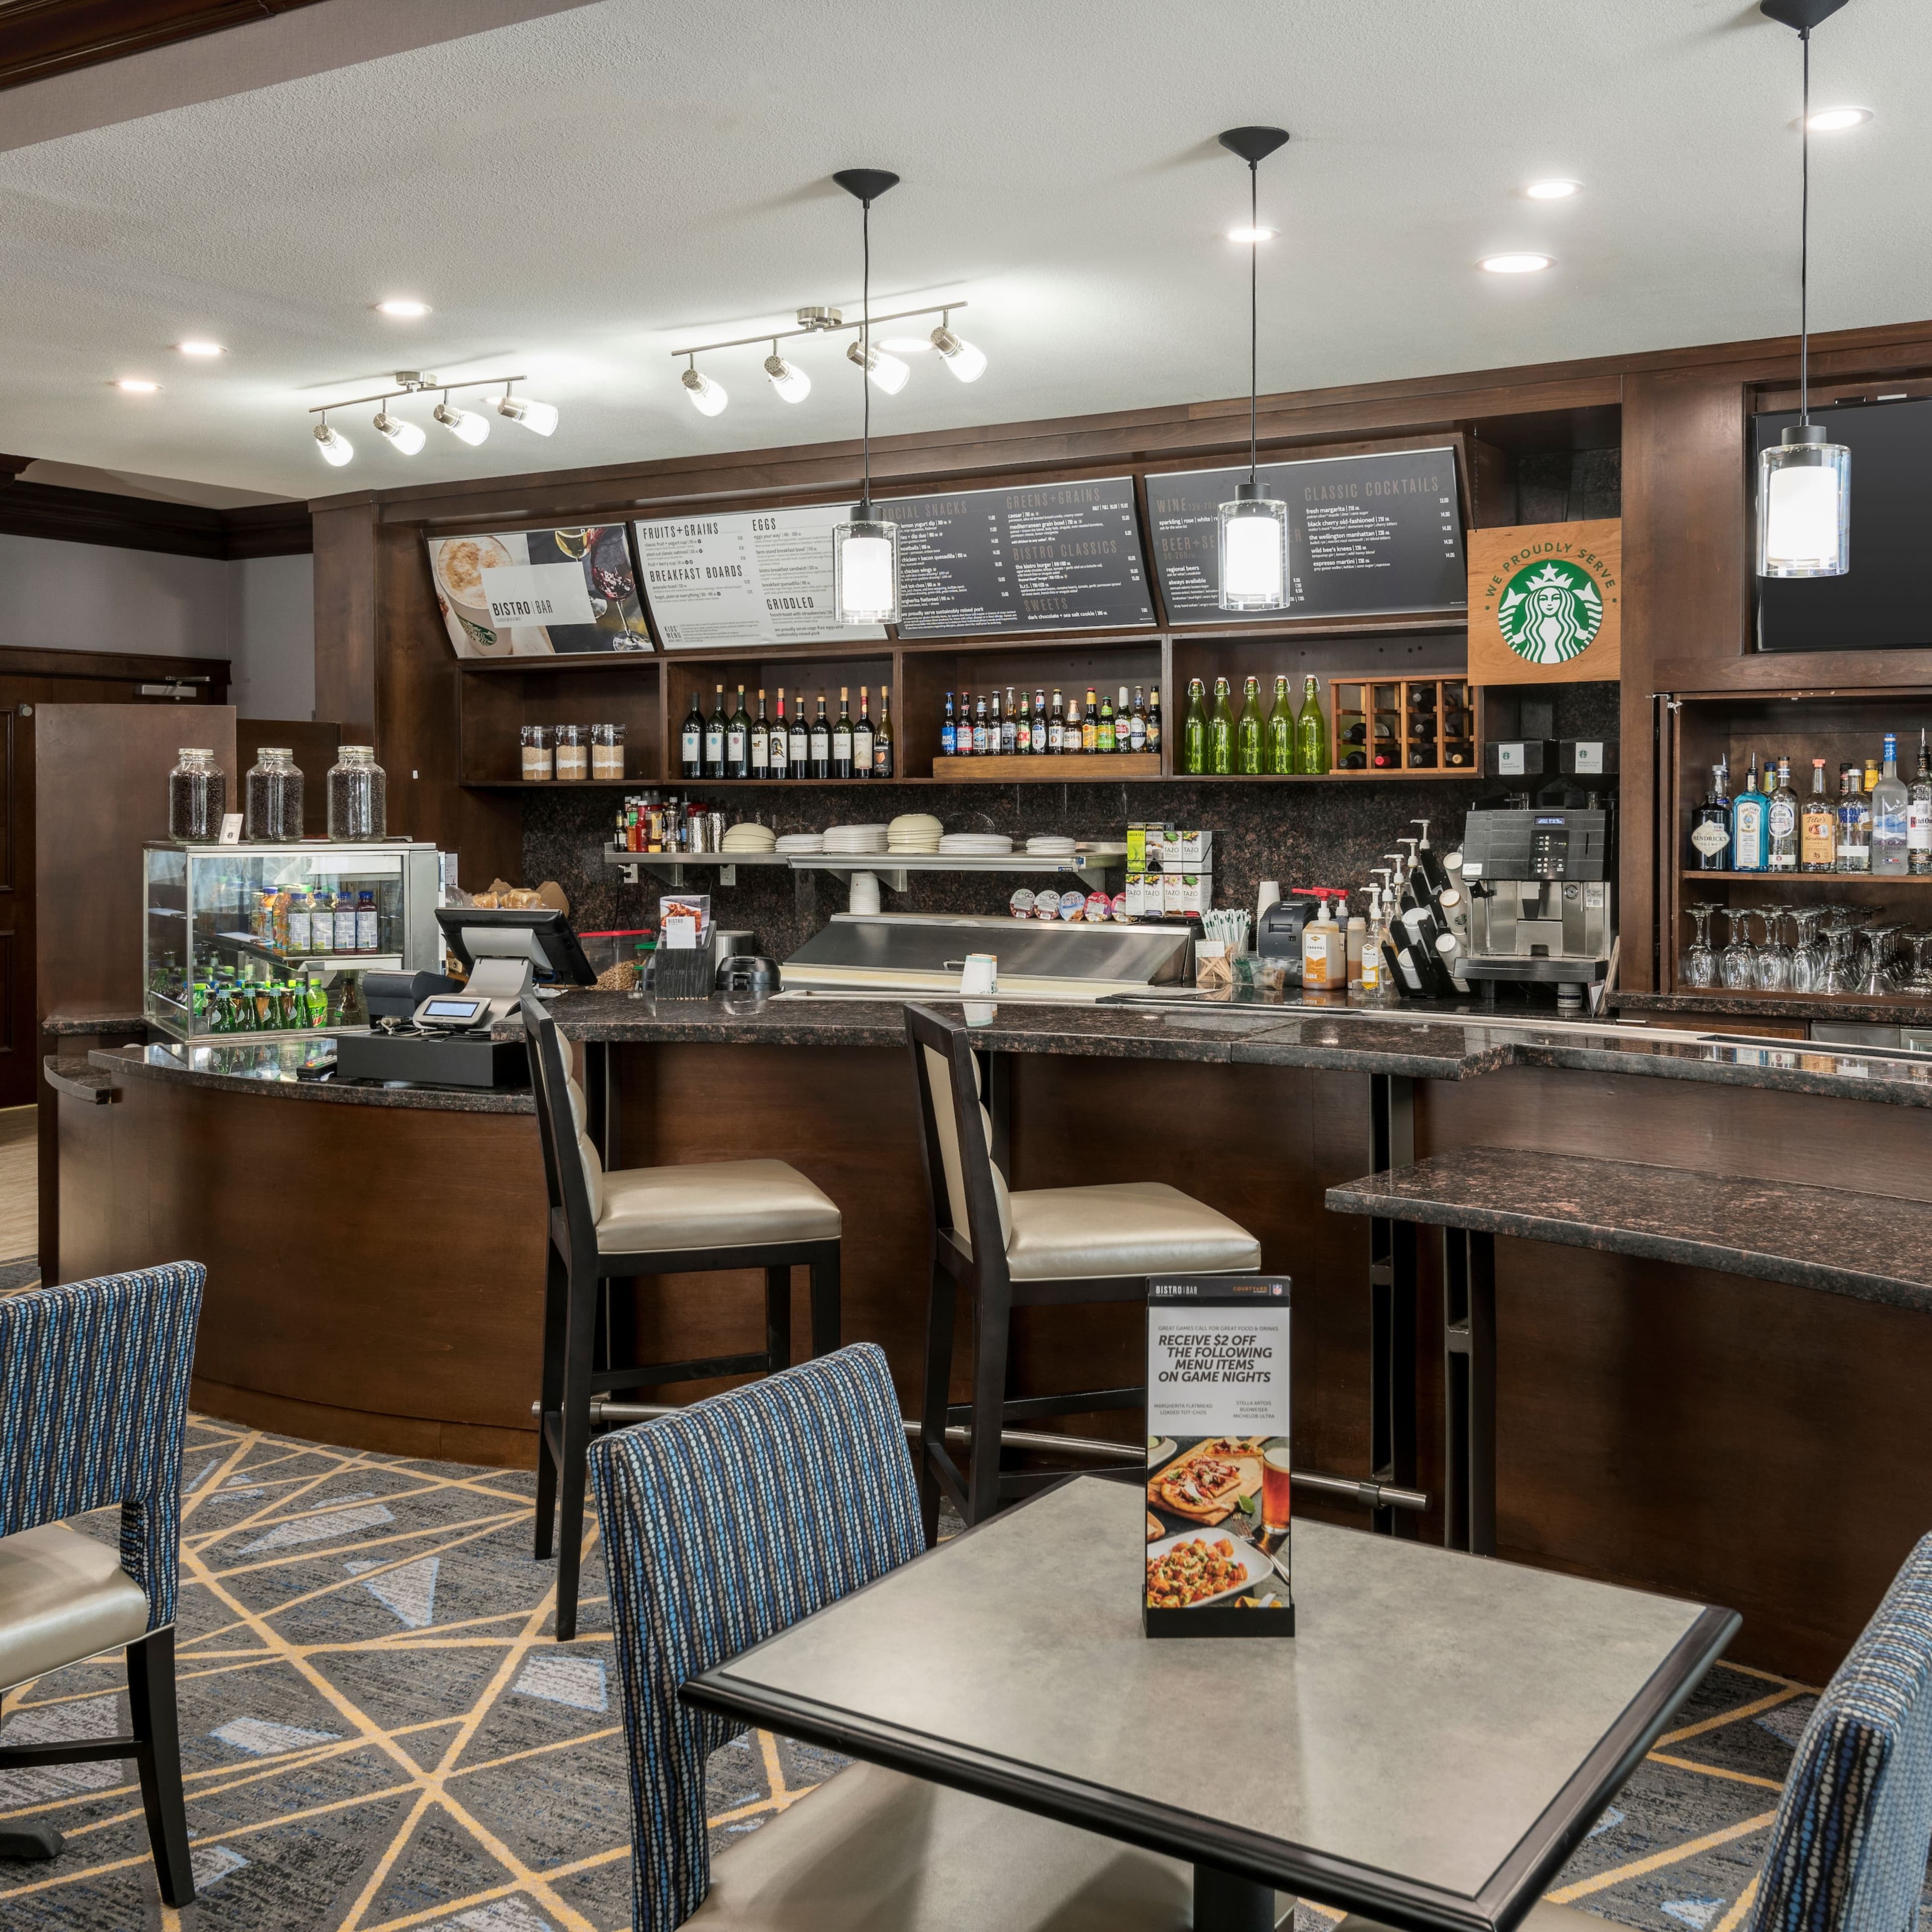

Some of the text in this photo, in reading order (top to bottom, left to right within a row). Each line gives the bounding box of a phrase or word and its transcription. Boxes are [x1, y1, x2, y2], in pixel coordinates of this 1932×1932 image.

[1305, 477, 1439, 501] CLASSIC COCKTAILS
[1006, 488, 1100, 509] GREENS+GRAINS
[1157, 498, 1186, 513] WINE
[926, 501, 967, 517] SNACKS
[643, 522, 718, 539] FRUITS+GRAINS
[753, 518, 776, 531] EGGS
[1013, 540, 1117, 561] BISTRO CLASSICS
[650, 565, 742, 582] BREAKFAST BOARDS
[1485, 542, 1616, 597] WE PROUDLY SERVE
[492, 600, 553, 616] BISTRO BAR
[766, 597, 814, 610] GRIDDLED
[1024, 597, 1068, 612] SWEETS
[1156, 1285, 1197, 1295] BISTRO BAR
[1159, 1334, 1256, 1346] RECEIVE $2 OFF
[1167, 1347, 1272, 1358] THE FOLLOWING
[1175, 1359, 1254, 1370] MENU ITEMS
[1158, 1372, 1271, 1383] ON GAME NIGHTS
